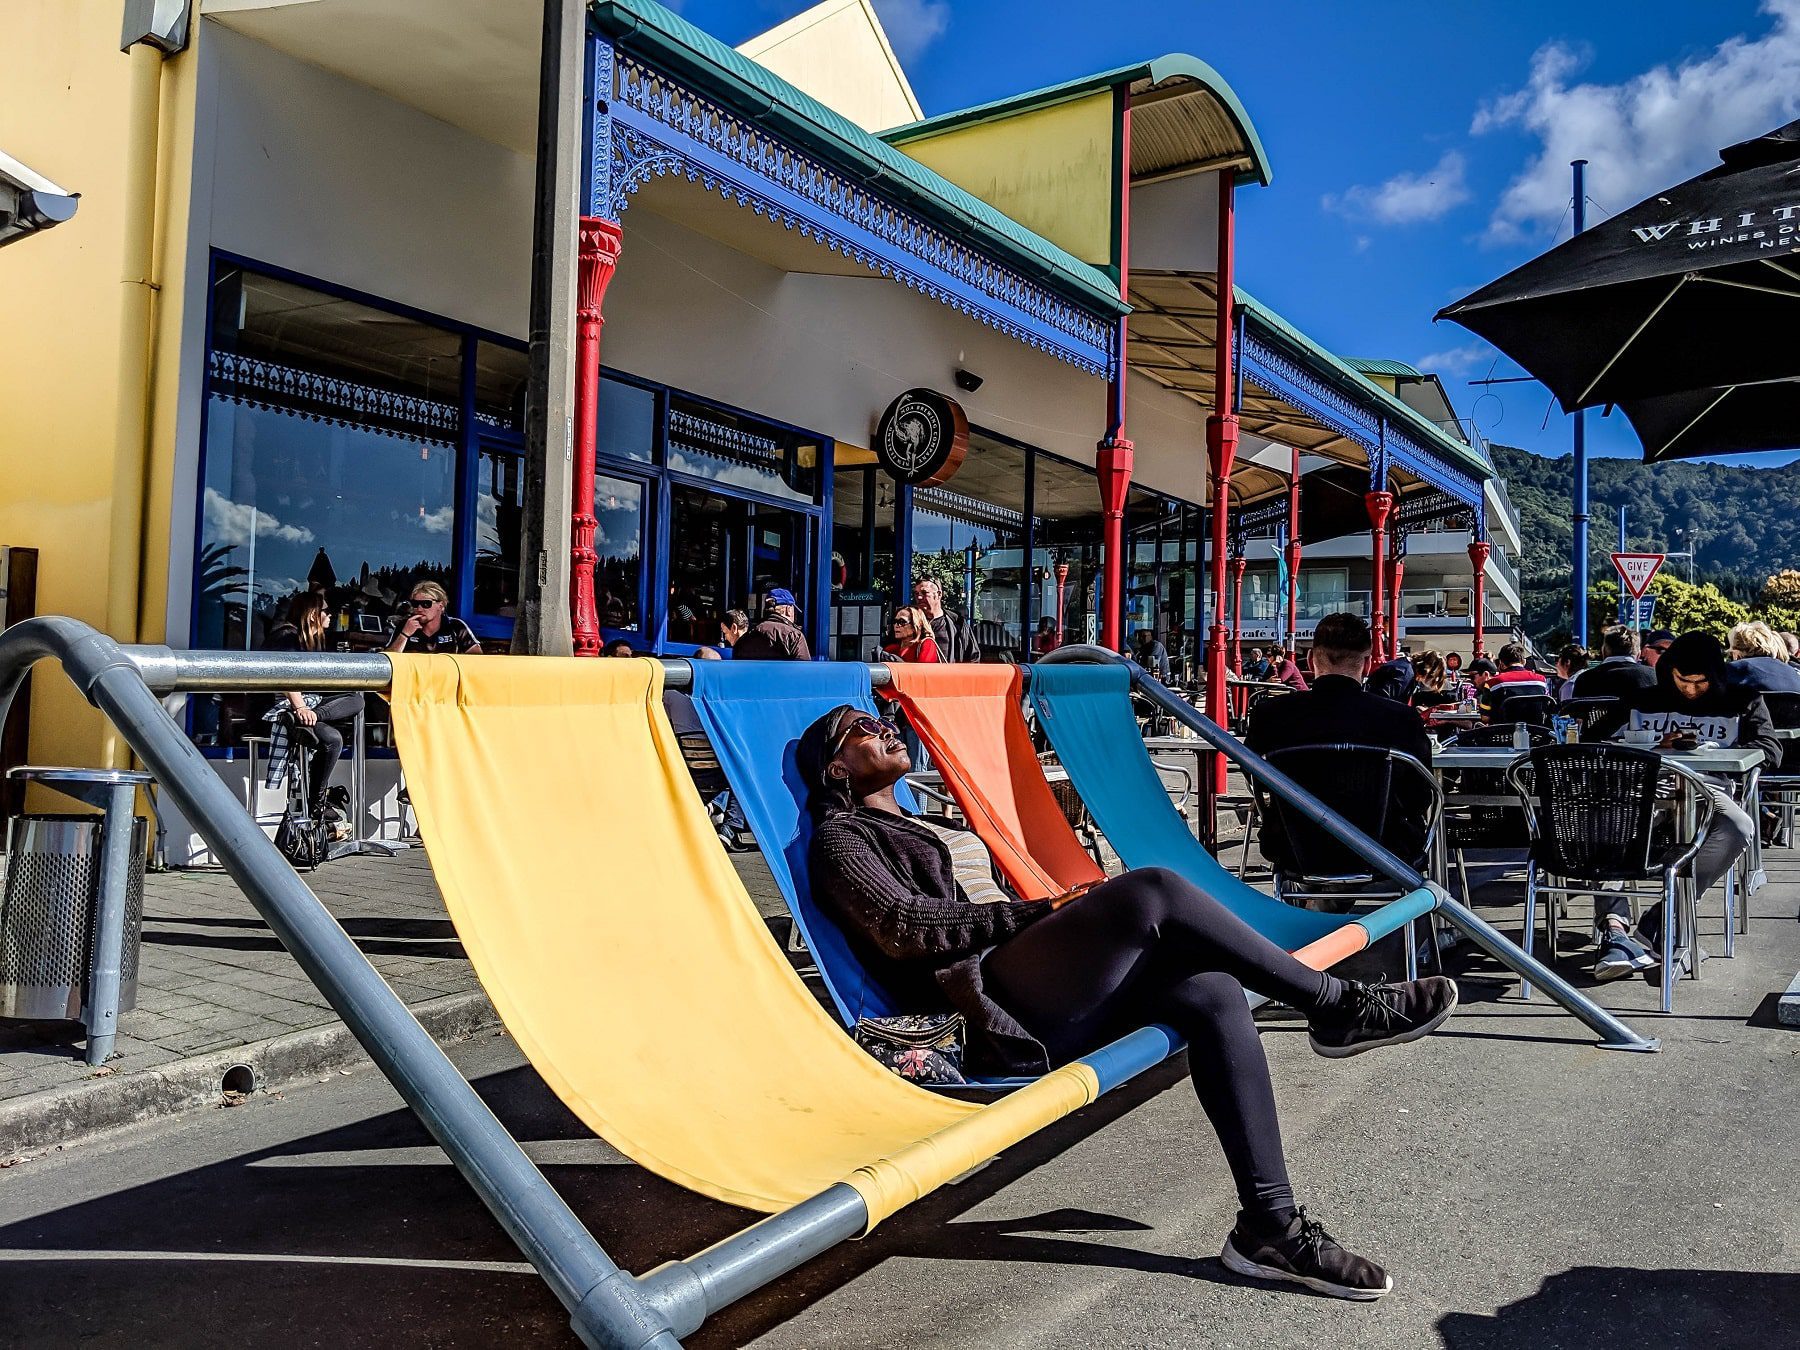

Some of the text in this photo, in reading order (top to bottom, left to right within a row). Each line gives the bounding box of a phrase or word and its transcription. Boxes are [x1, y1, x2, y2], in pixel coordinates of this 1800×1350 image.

[1631, 205, 1800, 243] WHIT
[1688, 223, 1800, 250] WINES O
[900, 405, 938, 463] MOA BREWING COMPANY
[1627, 561, 1648, 571] GIVE
[1631, 574, 1644, 582] WAY
[839, 592, 873, 601] Seabreeze
[1242, 629, 1267, 638] café
